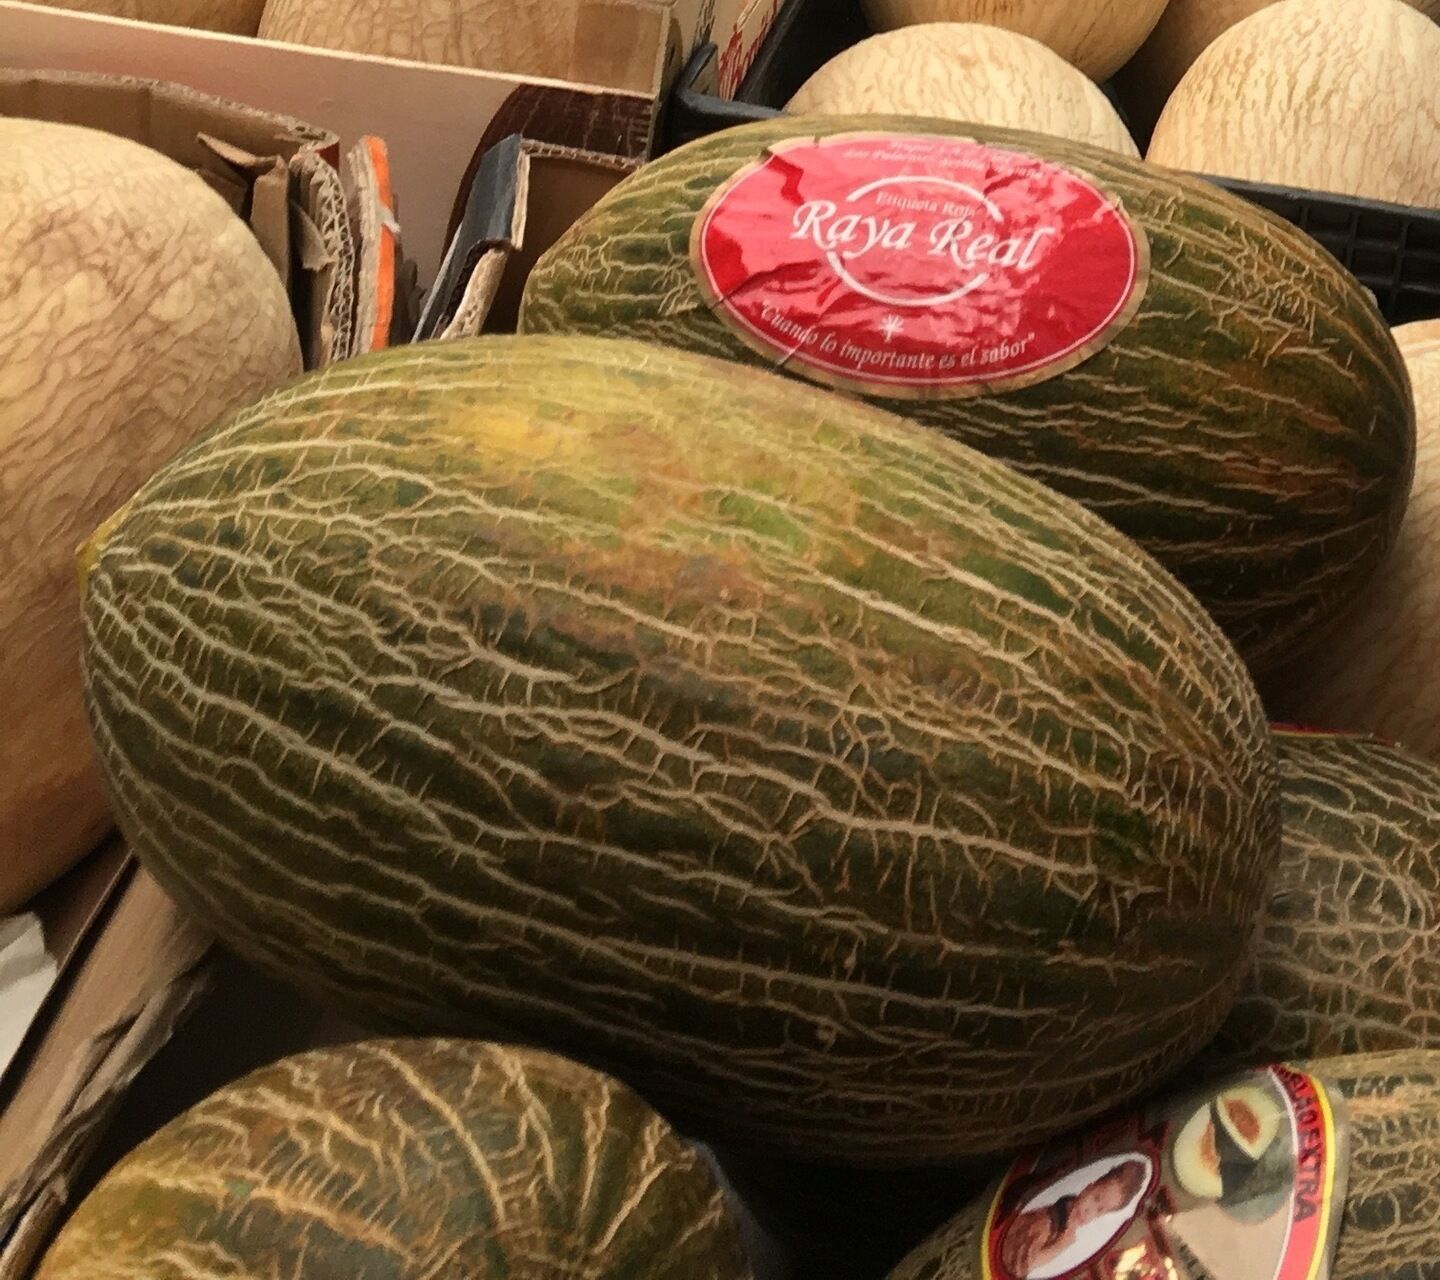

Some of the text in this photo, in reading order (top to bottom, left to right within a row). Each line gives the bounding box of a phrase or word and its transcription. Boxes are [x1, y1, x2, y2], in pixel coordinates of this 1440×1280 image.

[789, 199, 1057, 272] Raya Real
[819, 330, 838, 354] lo
[838, 339, 936, 371] importante
[937, 353, 957, 371] es
[960, 347, 977, 366] el
